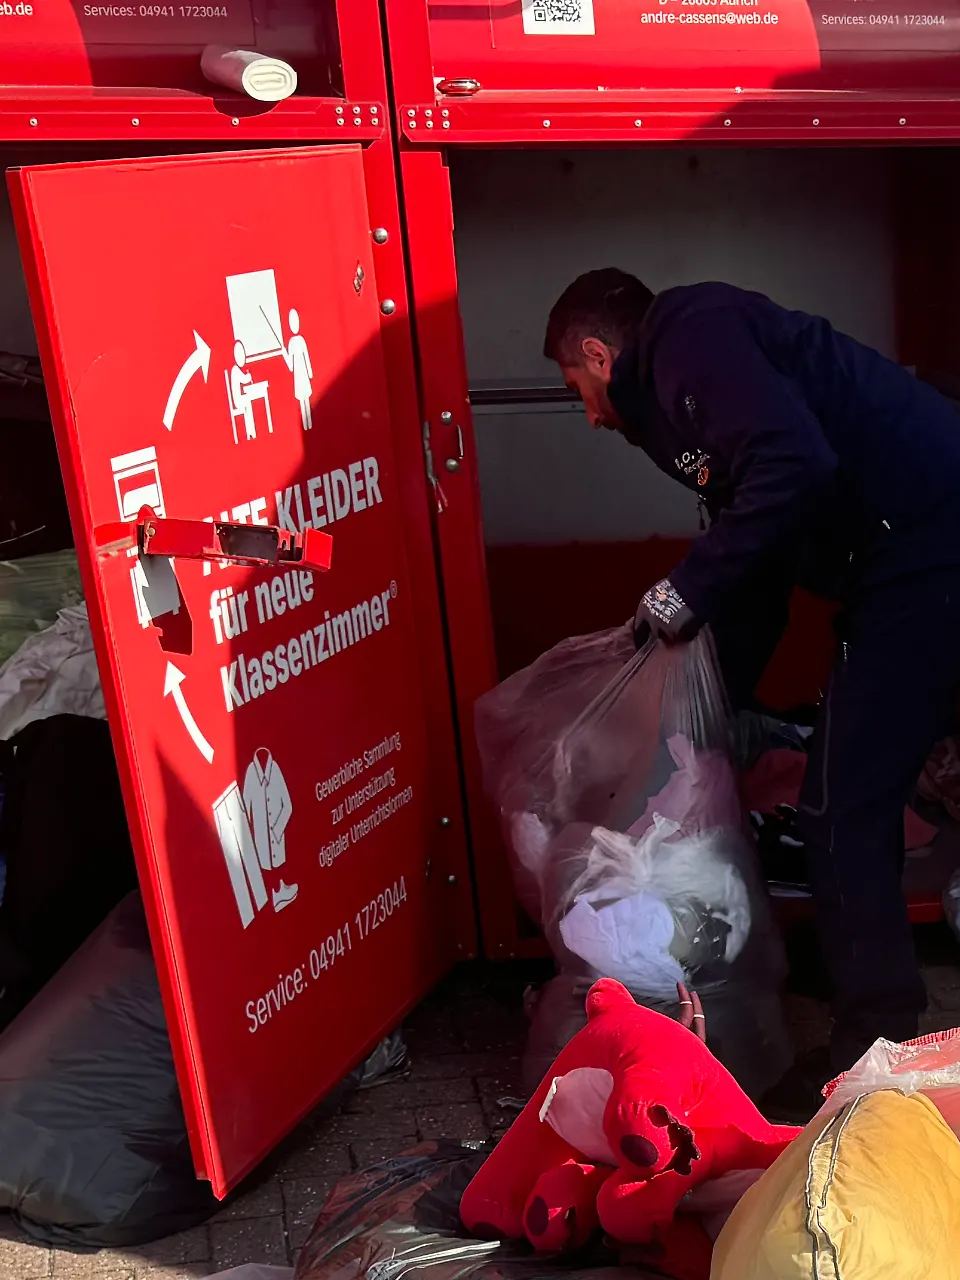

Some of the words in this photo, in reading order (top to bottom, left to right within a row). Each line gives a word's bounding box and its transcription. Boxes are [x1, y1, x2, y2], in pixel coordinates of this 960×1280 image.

[84, 5, 136, 17] Services:
[139, 6, 174, 17] 04941
[179, 6, 228, 18] 1723044
[640, 11, 779, 24] andre-cassens@web.de
[822, 14, 867, 25] Services:
[869, 14, 900, 25] 04941
[903, 15, 945, 26] 1723044
[275, 456, 383, 537] KLEIDER
[209, 586, 249, 644] für
[255, 569, 314, 624] neue
[315, 757, 363, 801] Gewerbliche
[363, 731, 401, 769] Sammlung
[331, 803, 344, 825] zur
[345, 766, 396, 814] Unterstützung
[319, 832, 349, 867] digitaler
[350, 785, 413, 843] Unterrichtsformen
[245, 963, 308, 1033] Service:
[309, 922, 352, 981] 04941
[355, 875, 407, 940] 1723044
